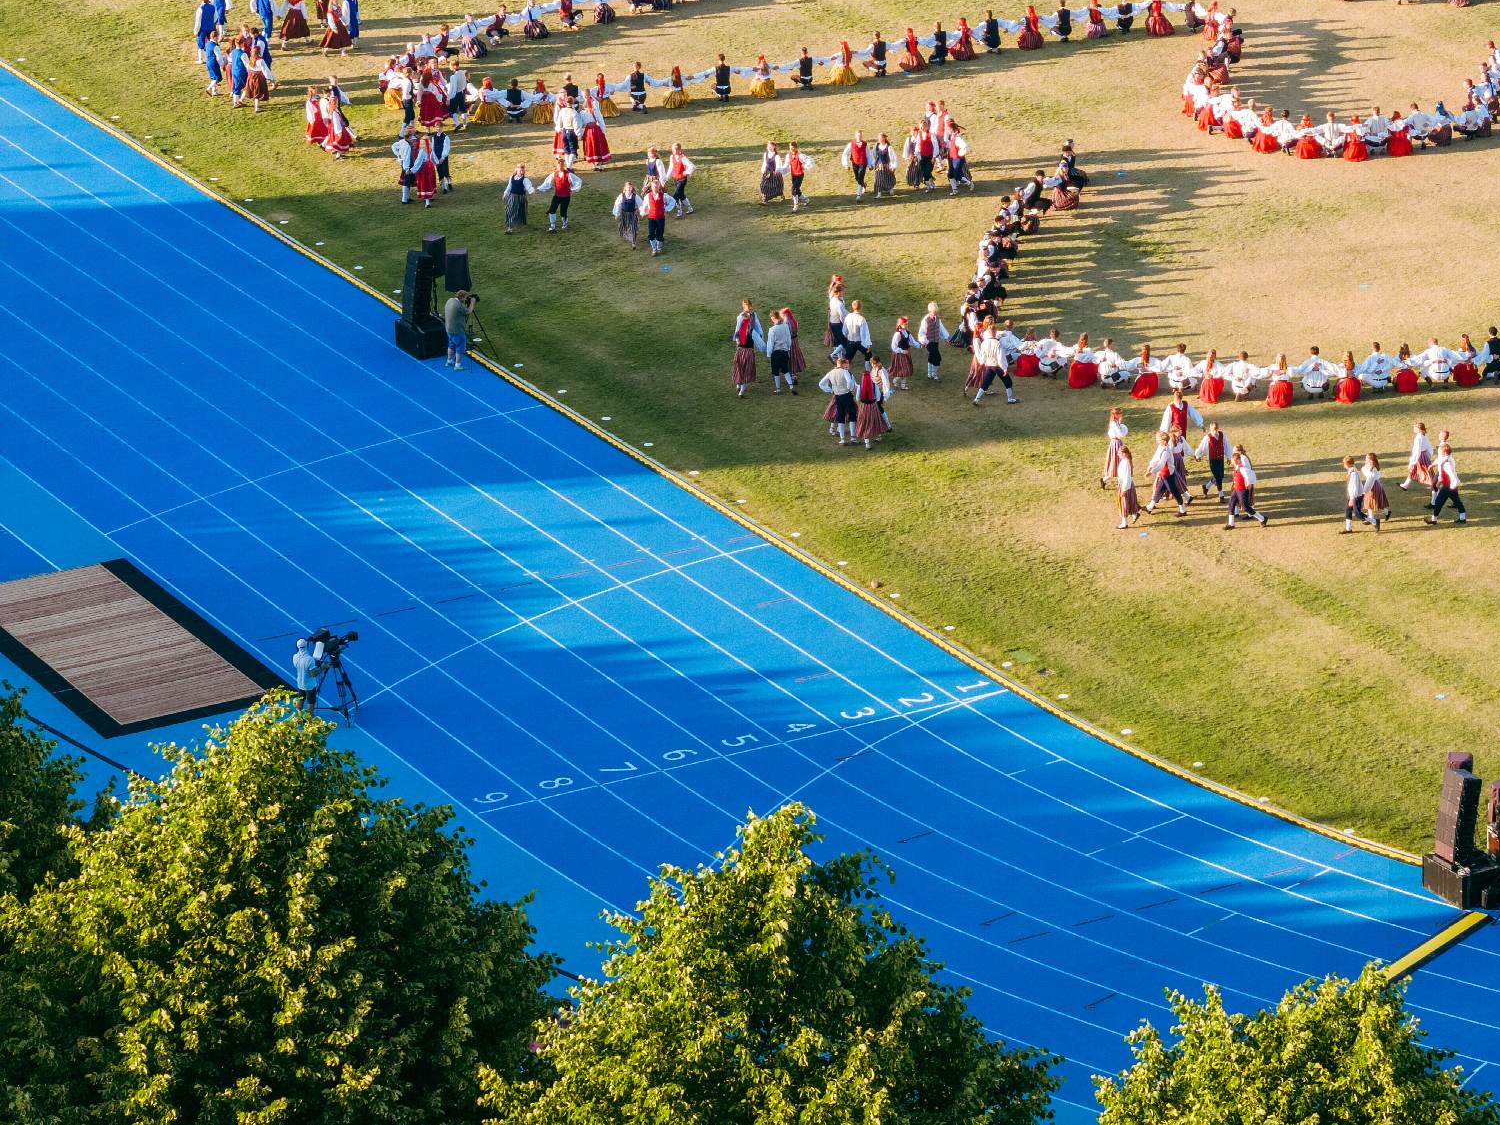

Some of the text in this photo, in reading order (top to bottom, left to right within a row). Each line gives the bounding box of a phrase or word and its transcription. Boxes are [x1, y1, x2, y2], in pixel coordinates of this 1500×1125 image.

[955, 680, 990, 693] 1
[897, 692, 934, 707] 2
[840, 706, 875, 720] 3
[786, 723, 817, 733] 4
[721, 733, 759, 747] 5
[662, 749, 698, 761] 6
[599, 761, 638, 772] 7
[538, 777, 574, 789] 8
[473, 792, 509, 804] 9
